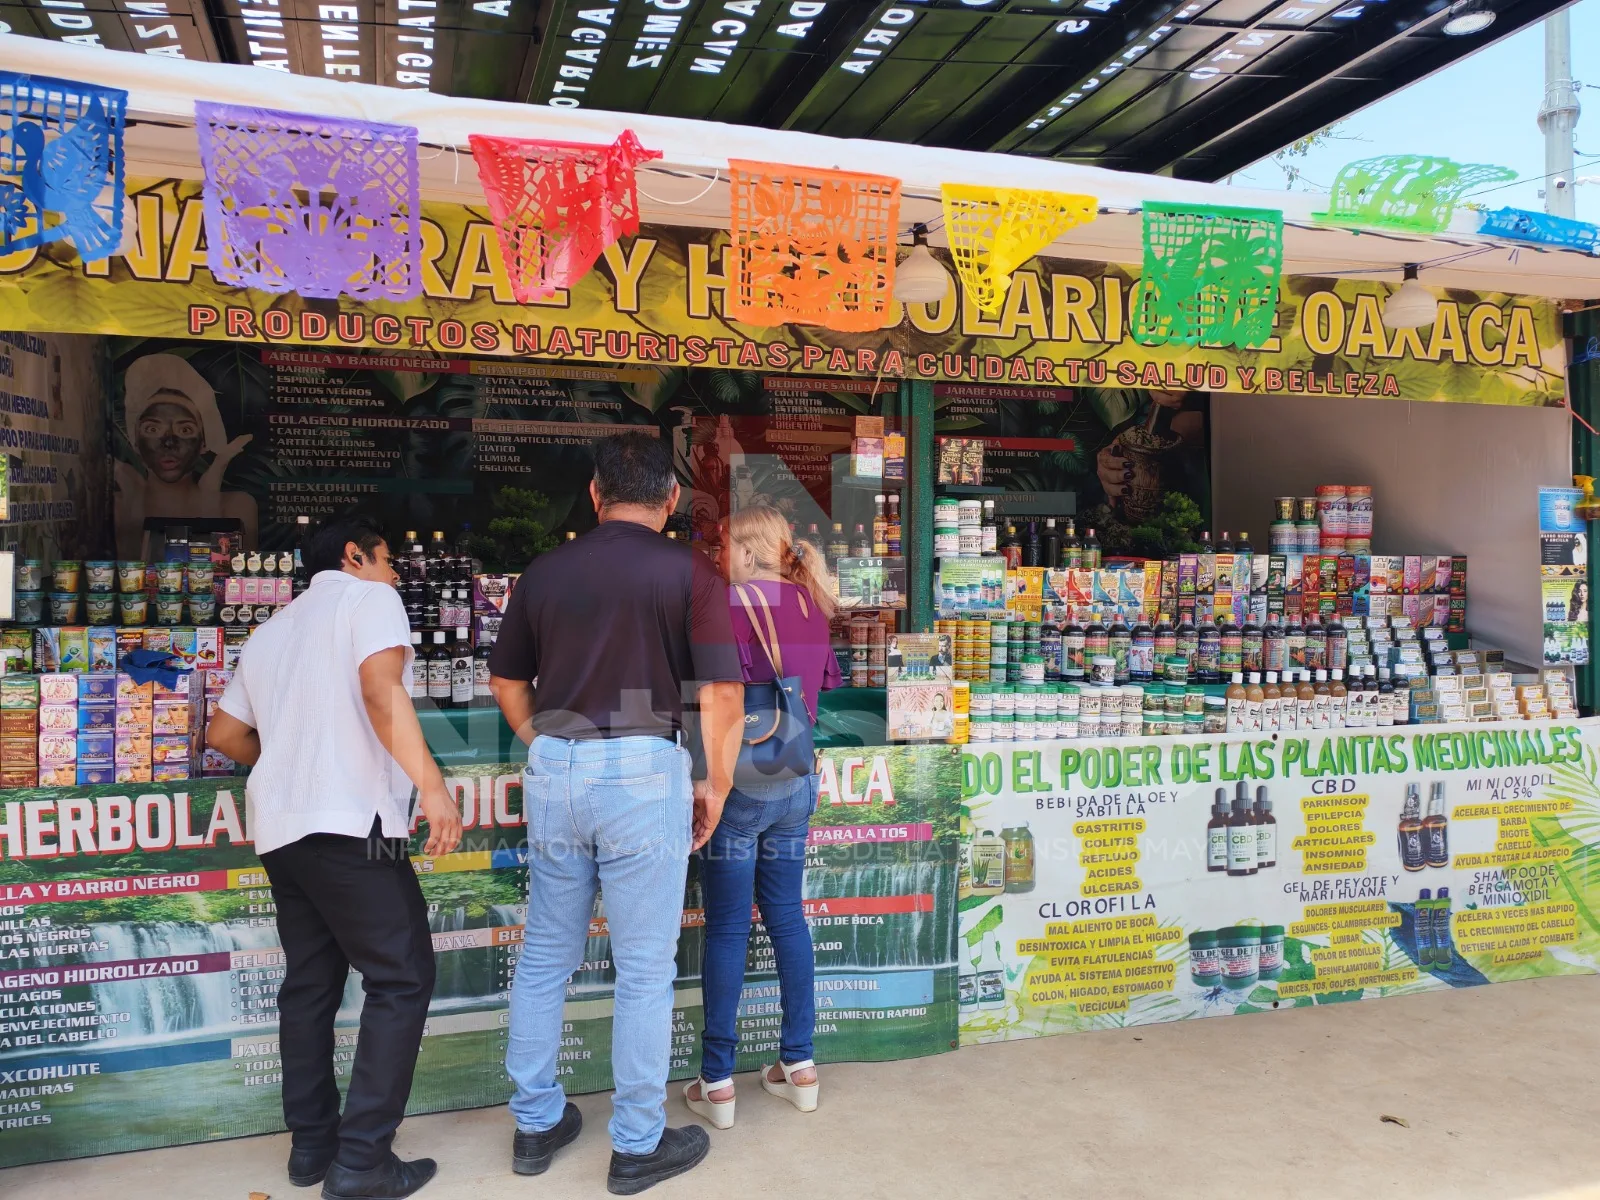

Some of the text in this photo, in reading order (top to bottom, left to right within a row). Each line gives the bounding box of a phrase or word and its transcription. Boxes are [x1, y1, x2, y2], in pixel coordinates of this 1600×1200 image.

[84, 194, 570, 308] NARAL
[600, 240, 661, 325] Y
[188, 306, 1400, 397] PRODUCTOS NATURISTAS PARA CUIDAR TU SALUD Y BELLEZA
[269, 351, 451, 370] ARCILLA Y BARRO NEGRO
[277, 375, 344, 385] ESPINILLAS
[768, 380, 870, 391] BEBIDA DE SABILA
[277, 386, 372, 397] PUNTOS NEGROS
[485, 387, 566, 397] ELIMINA CASPA
[945, 386, 1056, 399] JARABE PARA LA TOS
[269, 415, 450, 430] COLAGENO HIDROLIZADO
[277, 439, 375, 448] ARTICULACIONES
[277, 449, 401, 459] ANTIENVEJECIMIENTO
[479, 454, 521, 463] LUMBAR
[479, 464, 532, 473] ESGUINCES
[268, 482, 379, 493] TEPEXCOHUITE
[961, 726, 1582, 797] DO EL PODER DE LAS PLANTAS MEDICINALES
[1311, 779, 1356, 794] CBD
[1491, 787, 1532, 800] AL 5%
[1303, 797, 1366, 808] PARKINSON
[1454, 808, 1489, 817] ACELERA
[1492, 807, 1501, 815] EL
[1504, 802, 1558, 814] CRECIMIENTO
[1307, 810, 1363, 821] EPILEPCIA
[1500, 817, 1527, 826] BARBA
[0, 790, 255, 861] HERBOLA
[1075, 821, 1143, 835] GASTRITIS
[1309, 823, 1360, 834] DOLORES
[813, 827, 908, 841] PARA LA TOS
[1232, 835, 1252, 844] CBD
[1500, 829, 1529, 838] BIGOTE
[1084, 837, 1134, 849] COLITIS
[1295, 834, 1374, 848] ARTICULARES
[1498, 841, 1532, 850] CABELLO
[1081, 851, 1138, 864] REFLUJO
[1305, 848, 1364, 859] INSOMNIO
[1455, 857, 1482, 866] AYUDA
[1492, 854, 1519, 862] TRATAR
[1088, 866, 1132, 878] ACIDES
[1305, 861, 1364, 872] ANSIEDAD
[1474, 865, 1555, 883] SHAMPOO DE
[39, 884, 52, 897] Y
[57, 879, 128, 896] BARRO
[132, 874, 200, 890] NEGRO
[1083, 880, 1139, 895] ULCERAS
[1283, 875, 1399, 894] GEL DE PEYOTE Y
[1469, 877, 1559, 896] BERGAMOTA Y
[1300, 887, 1386, 902] MARIHUANA
[1039, 893, 1156, 919] CLOROFILA
[1306, 903, 1384, 917] DOLORES MUSCULARES
[1457, 912, 1493, 923] ACELERA
[1495, 912, 1500, 920] 3
[1503, 908, 1528, 919] VECES
[1547, 904, 1574, 914] RAPIDO
[834, 916, 884, 926] DE BOCA
[1048, 917, 1155, 936] MAL ALIENTO DE BOCA
[27, 928, 90, 945] NEGROS
[1019, 929, 1181, 953] DESINTOXICA Y LIMPIA EL HIGADO
[1333, 934, 1360, 944] LUMBAR
[1461, 942, 1495, 953] DETIENE
[1498, 941, 1507, 949] LA
[1510, 938, 1530, 948] CAIDA
[1540, 933, 1574, 943] COMBATE
[34, 941, 109, 957] MUERTAS
[1051, 949, 1154, 967] EVITA FLATULENCIAS
[64, 959, 199, 983] HIDROLIZADO
[1318, 962, 1379, 976] DESINFLAMATORIO
[888, 1007, 927, 1018] RAPIDO
[1079, 999, 1127, 1013] VECICULA
